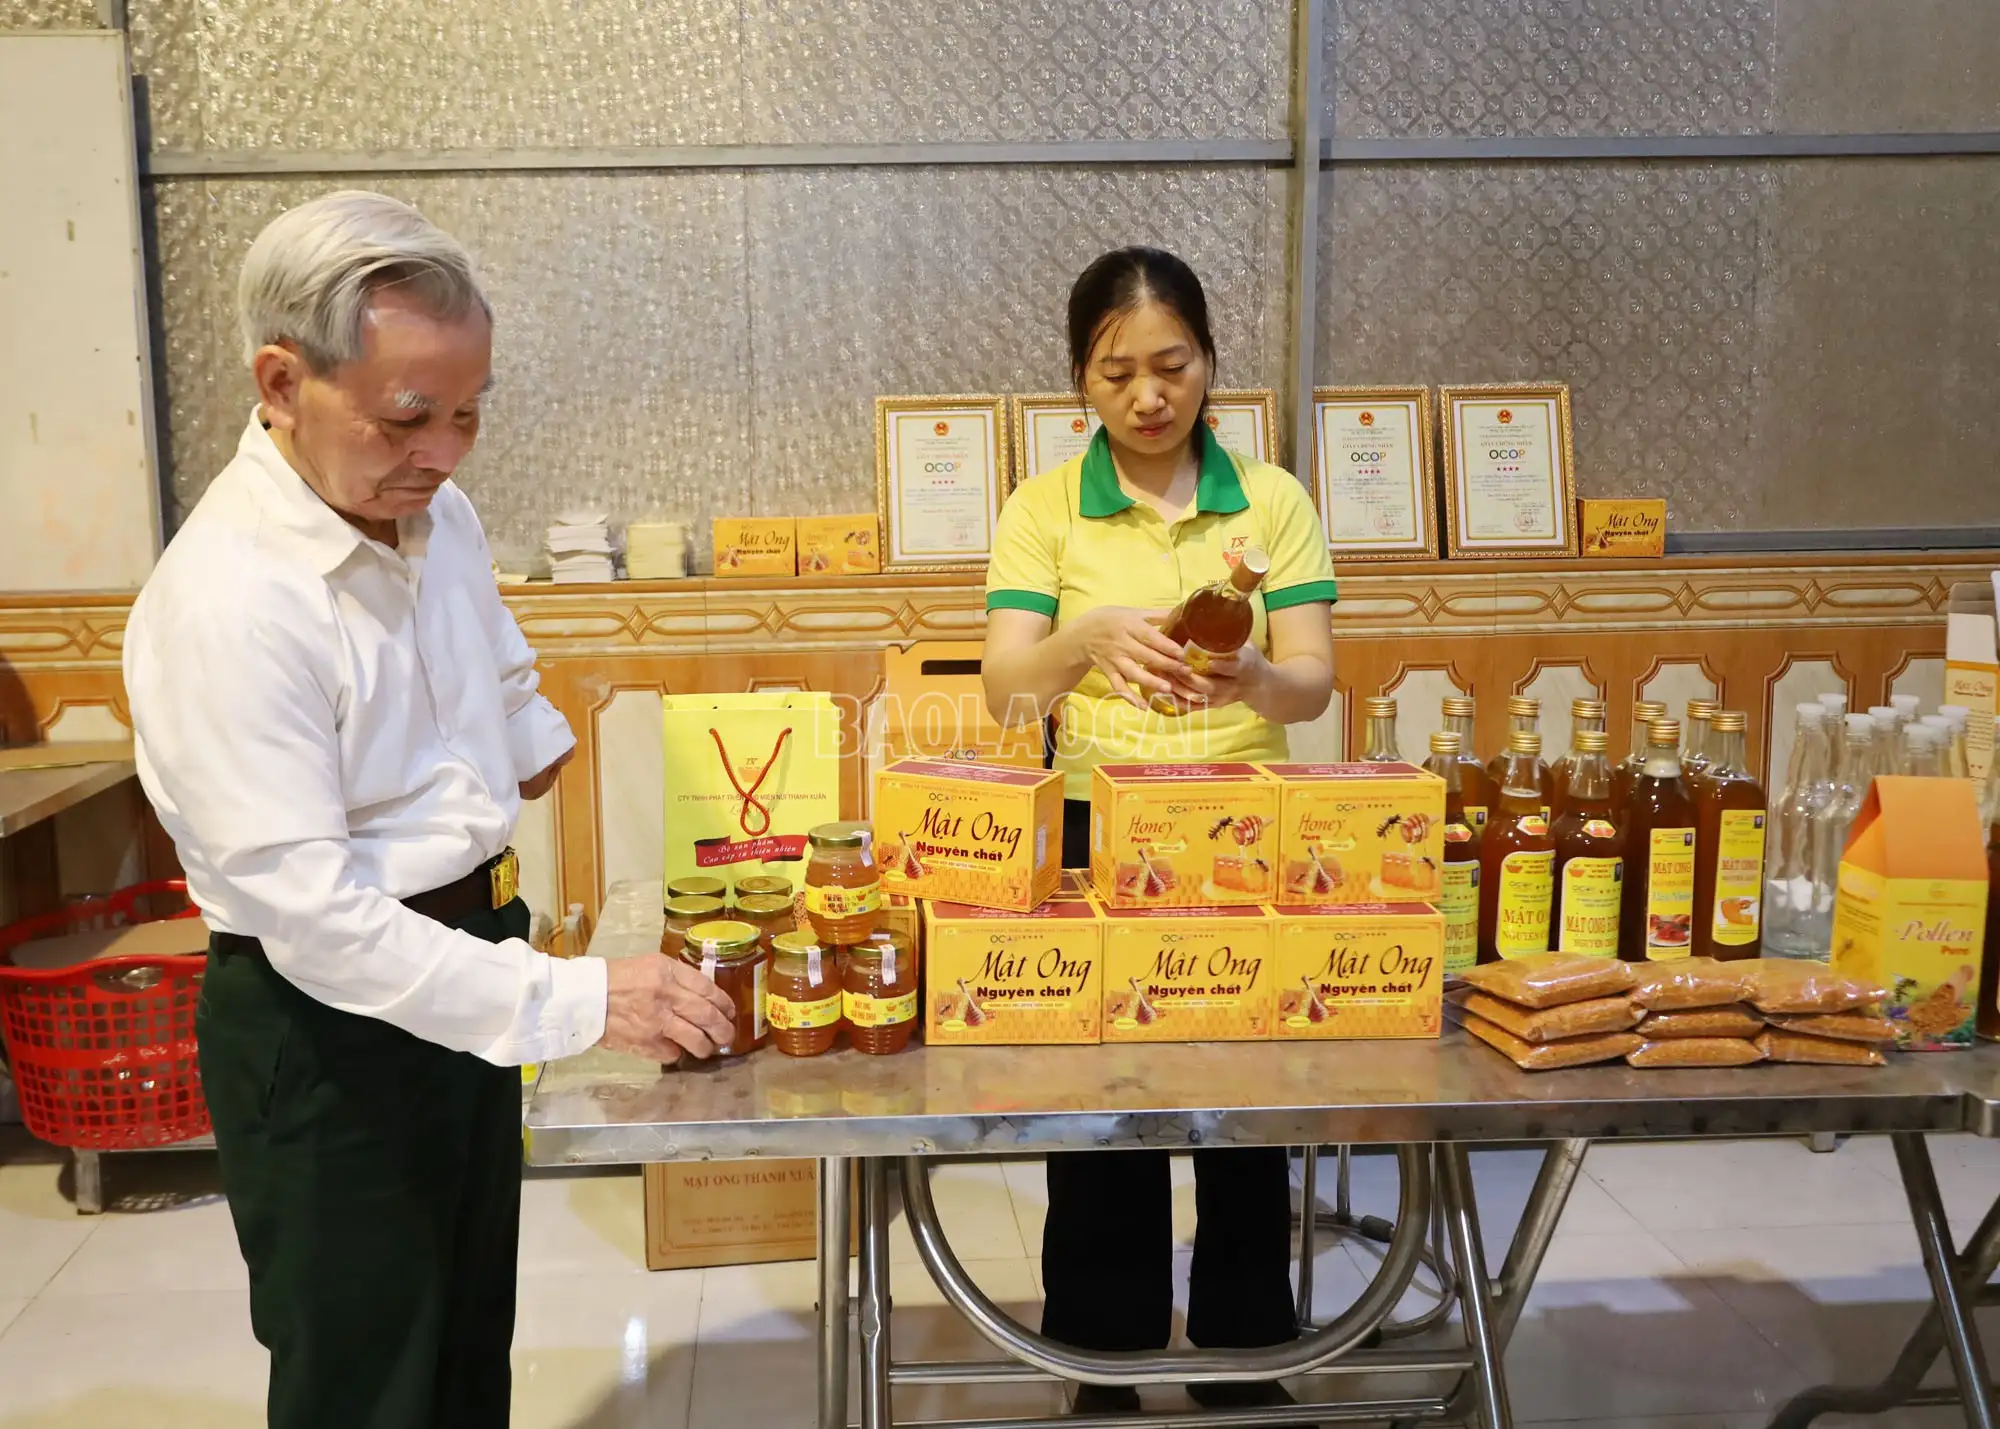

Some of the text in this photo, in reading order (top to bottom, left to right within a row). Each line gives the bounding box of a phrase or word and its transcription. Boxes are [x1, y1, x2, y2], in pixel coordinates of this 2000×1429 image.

[1350, 452, 1386, 462] OCOP
[1489, 449, 1526, 460] OCOP
[924, 462, 961, 473] OCOP
[1632, 512, 1659, 534] Ong
[764, 530, 790, 552] Ong
[1231, 536, 1248, 548] TX
[678, 794, 690, 802] CTY
[708, 792, 726, 801] PHÁT
[810, 792, 827, 800] XUÂN
[913, 808, 1022, 860] Mật Ong
[1123, 813, 1177, 840] Honey
[1293, 812, 1348, 837] Honey
[916, 841, 1002, 862] Nguyên chất
[1504, 906, 1535, 928] MẬT
[1896, 919, 1974, 942] Pollen
[970, 948, 1092, 995] Mật Ong
[1143, 946, 1262, 993] Mật Ong
[1316, 944, 1434, 990] Mật Ong
[976, 986, 1072, 1000] Nguyên chất
[1148, 984, 1242, 998] Nguyên chất
[1320, 982, 1413, 996] Nguyên chất
[713, 1174, 740, 1187] ONG
[744, 1170, 786, 1186] THANH
[788, 1164, 816, 1182] XUÂ
